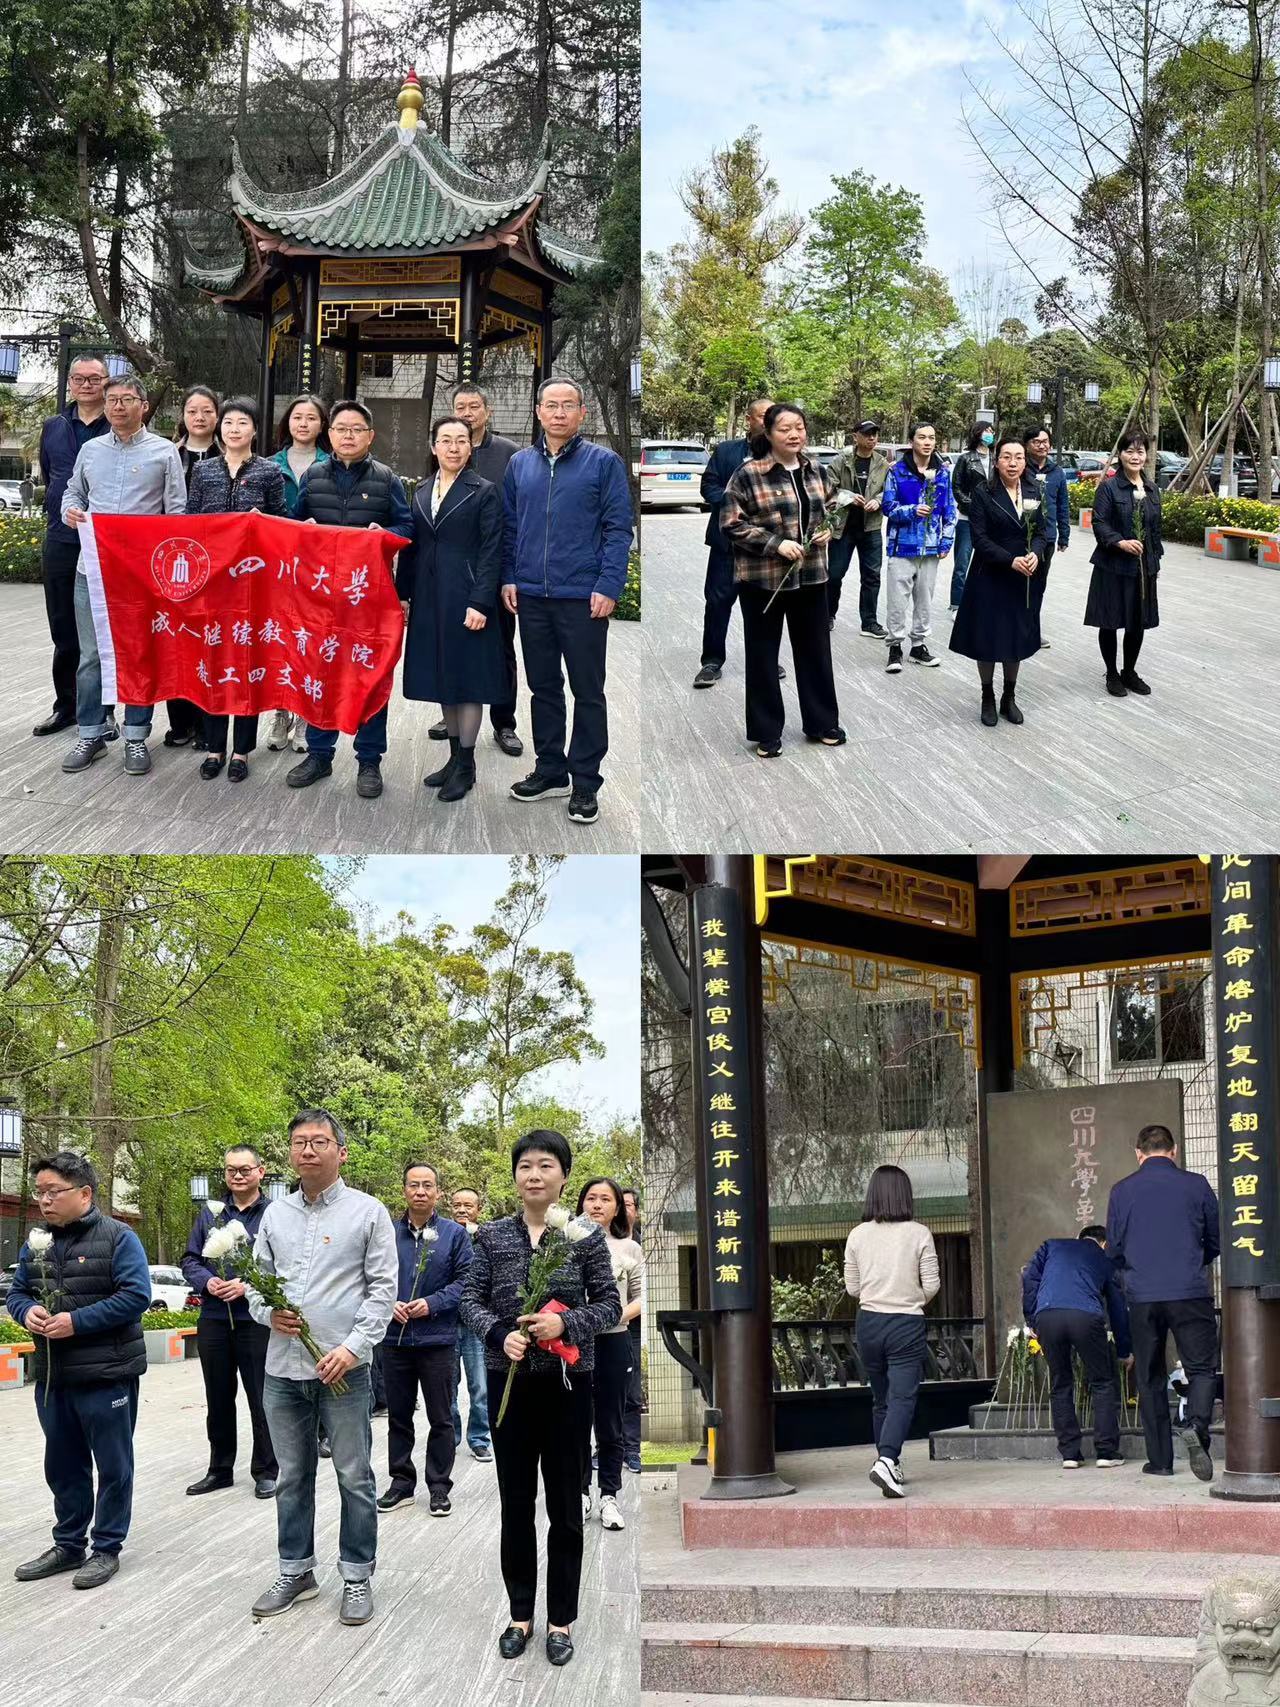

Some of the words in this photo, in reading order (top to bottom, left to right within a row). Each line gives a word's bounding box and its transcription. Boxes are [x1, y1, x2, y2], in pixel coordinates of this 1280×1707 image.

[151, 610, 376, 670] 成人继续教育学院
